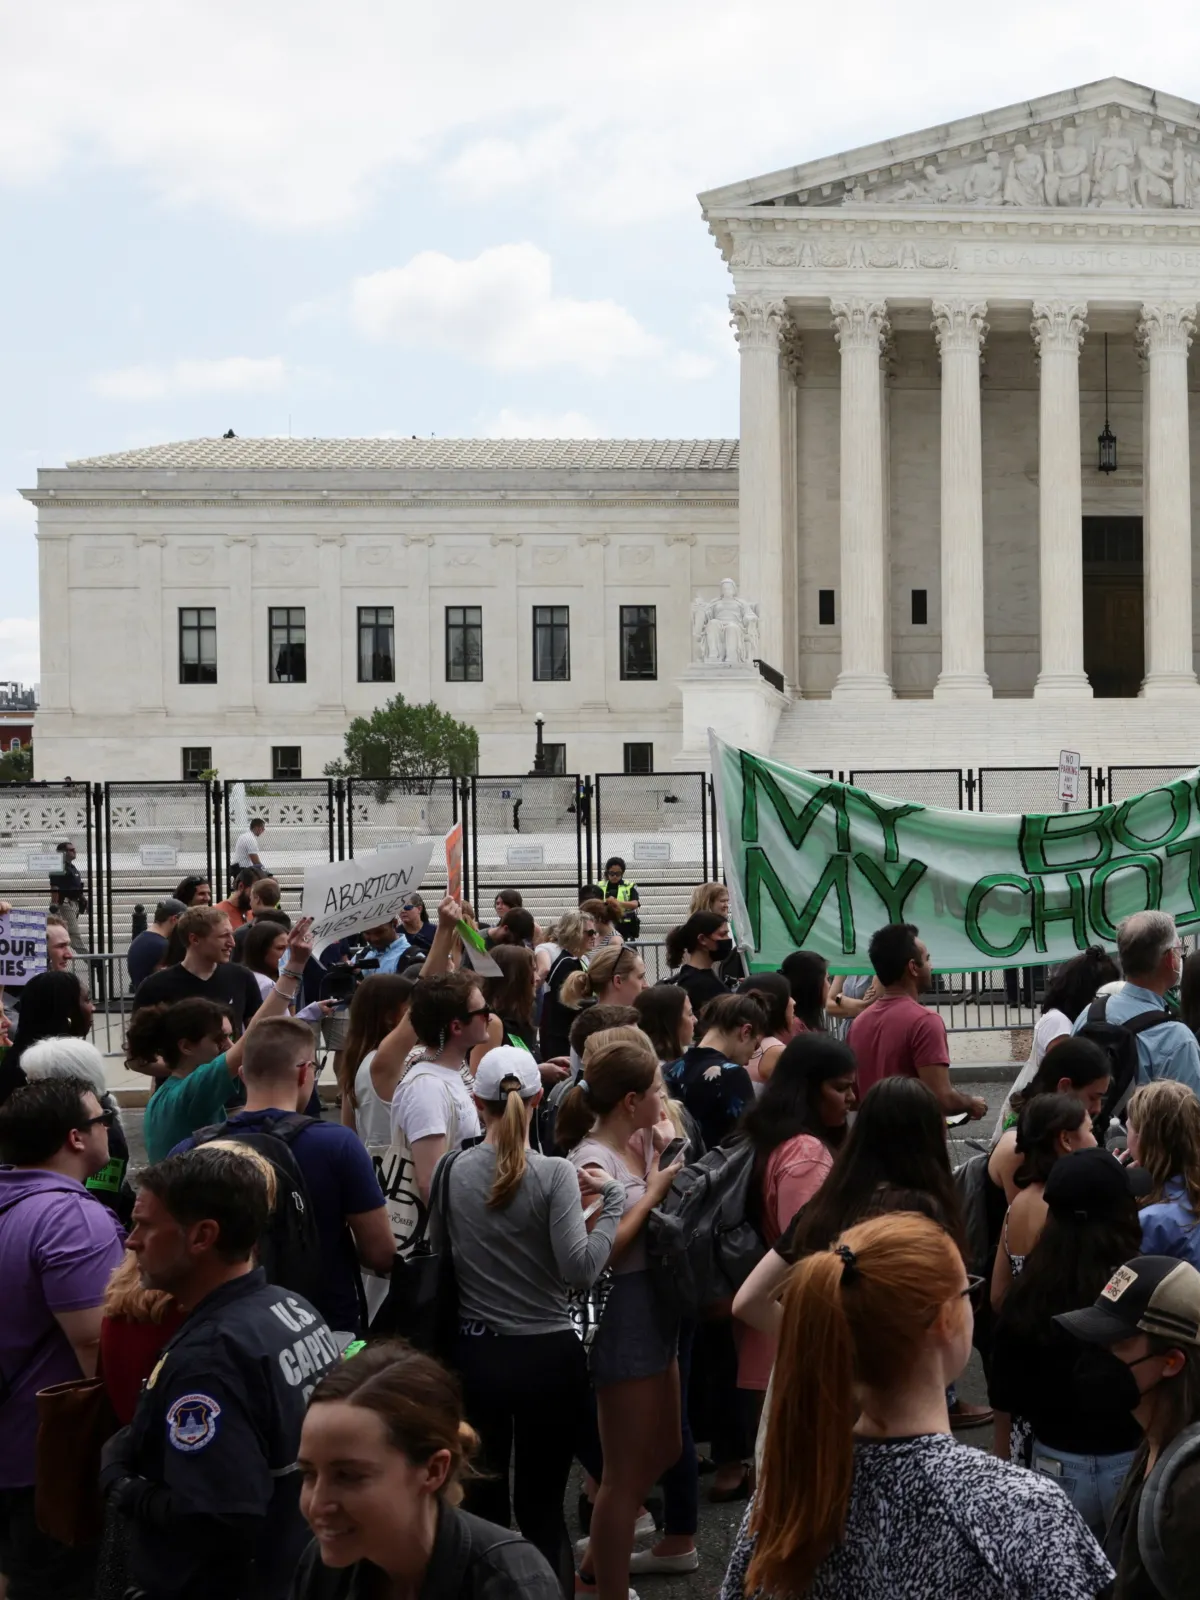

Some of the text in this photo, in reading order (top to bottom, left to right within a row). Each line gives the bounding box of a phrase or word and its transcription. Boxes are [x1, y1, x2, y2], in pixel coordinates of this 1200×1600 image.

[973, 249, 1042, 266] EQUAL
[1048, 249, 1129, 267] JUSTICE
[1060, 765, 1078, 775] PARKING
[1065, 754, 1074, 764] NO
[739, 749, 926, 863] MY
[324, 866, 414, 914] ABORTION
[743, 846, 927, 955] MY
[311, 894, 413, 939] SAVES LIVES
[269, 1297, 316, 1332] U.S.
